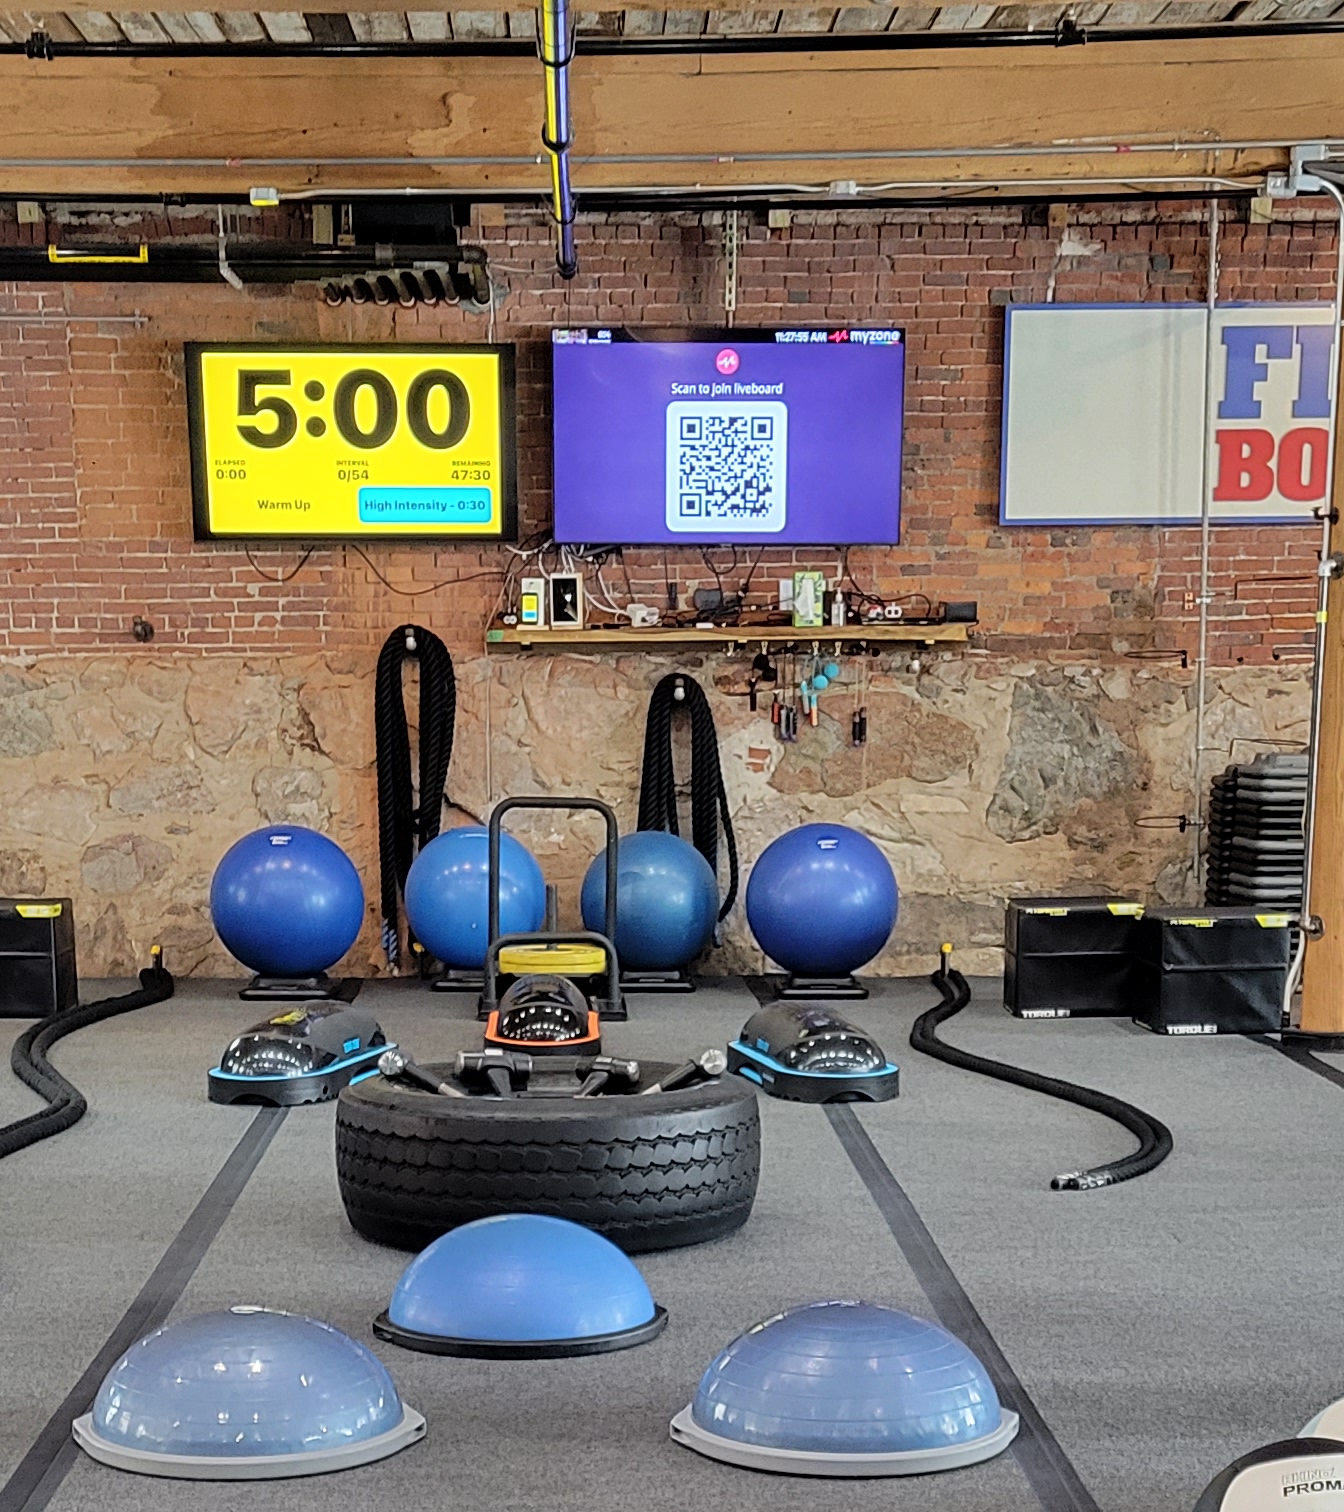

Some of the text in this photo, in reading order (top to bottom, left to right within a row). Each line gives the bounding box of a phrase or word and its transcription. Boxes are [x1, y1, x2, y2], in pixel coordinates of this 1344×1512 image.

[850, 331, 900, 345] myzone
[671, 382, 784, 398] Scan to join liveboard
[236, 368, 471, 449] 5:00
[216, 469, 246, 480] 0:00
[337, 469, 369, 483] 0/54
[451, 469, 491, 481] 47:30
[257, 499, 311, 512] Warm Up
[365, 500, 392, 512] High
[394, 500, 448, 512] Intensity
[457, 500, 486, 510] 0:30
